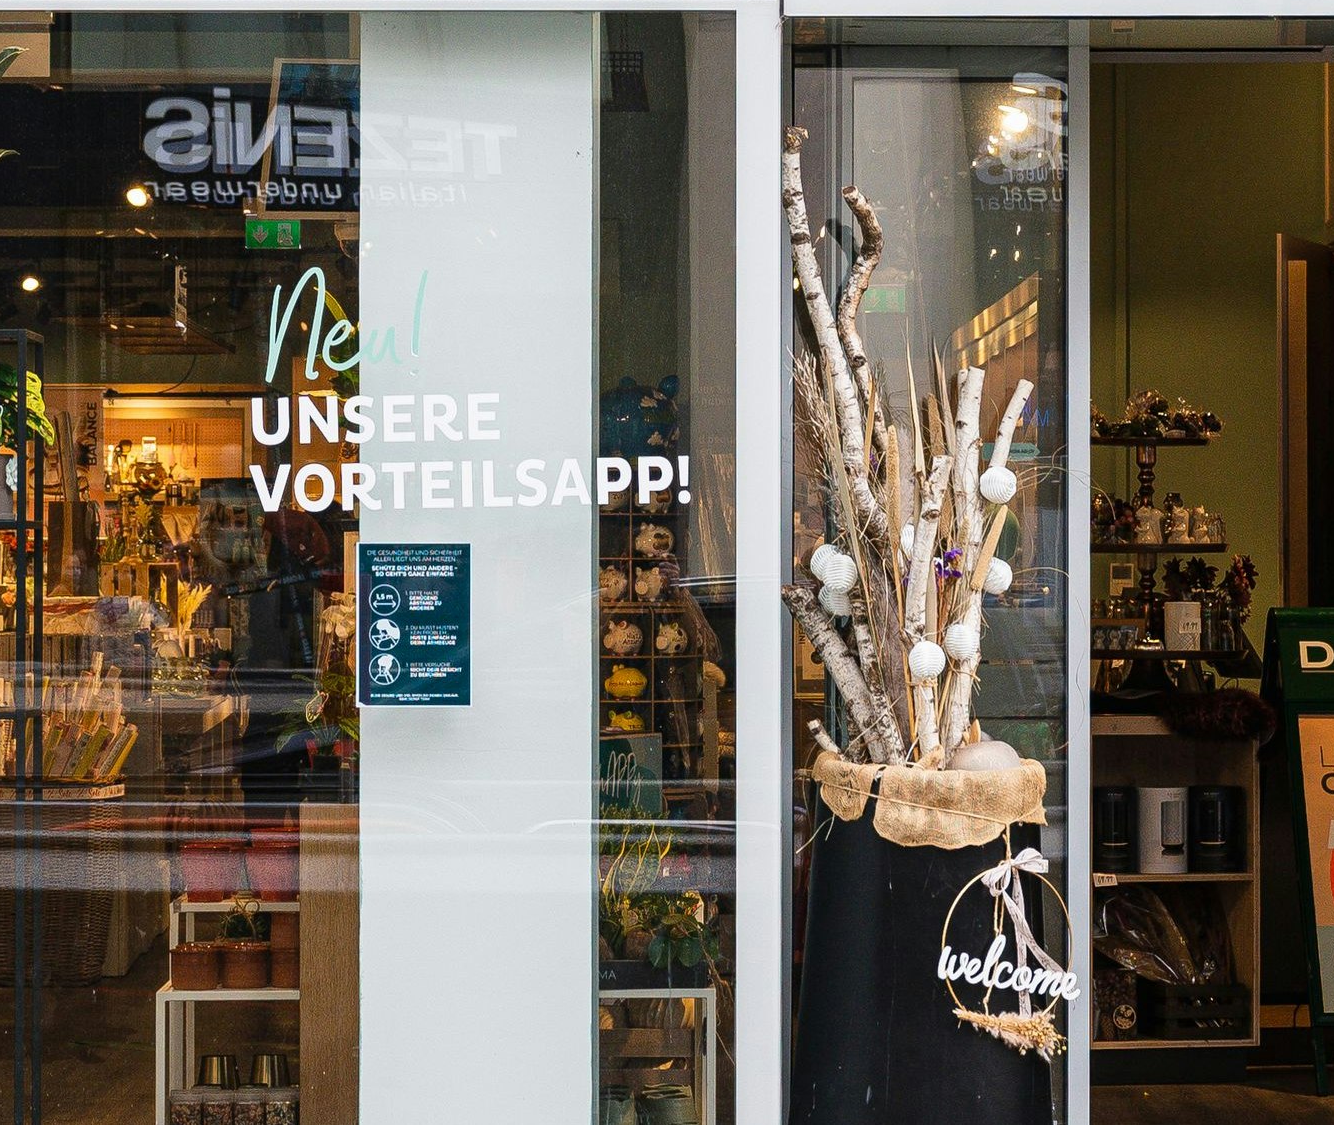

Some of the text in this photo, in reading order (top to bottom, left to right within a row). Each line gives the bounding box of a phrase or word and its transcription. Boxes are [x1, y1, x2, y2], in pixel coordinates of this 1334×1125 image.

[264, 266, 429, 384] Neu!
[87, 401, 98, 466] BALANCE
[249, 392, 502, 447] UNSERE
[248, 454, 693, 514] VORTEILSAPP!
[937, 934, 1081, 1001] welcome
